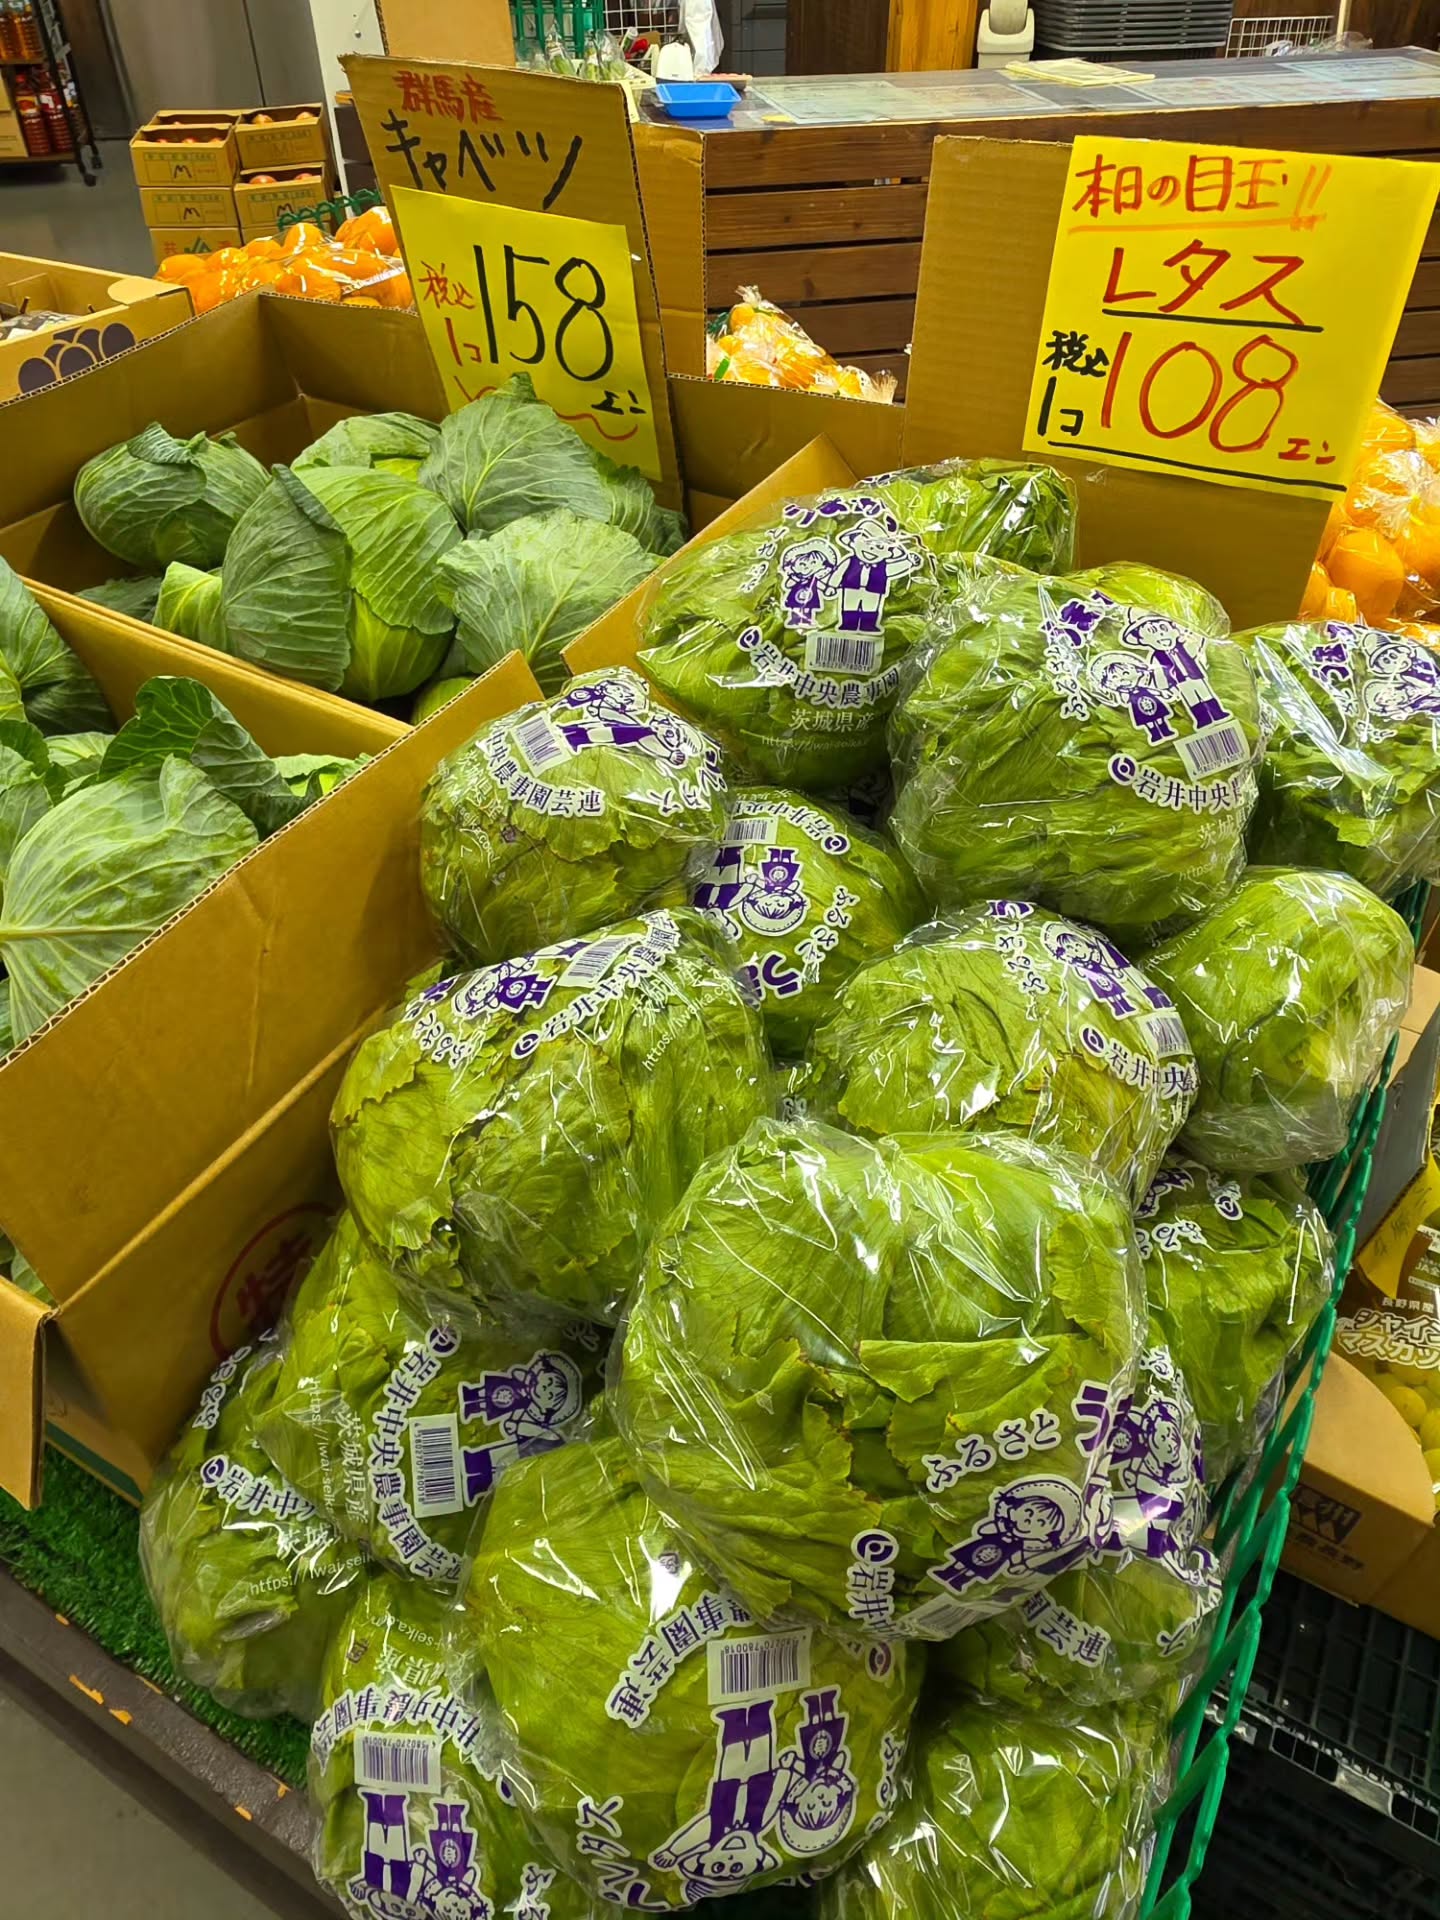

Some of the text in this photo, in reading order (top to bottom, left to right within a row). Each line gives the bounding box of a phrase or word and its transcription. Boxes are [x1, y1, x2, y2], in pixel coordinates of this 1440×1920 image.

[394, 68, 503, 124] 群馬産
[380, 107, 583, 210] キャベツ
[472, 243, 615, 382] 158
[1102, 238, 1304, 328] レタス
[1101, 331, 1300, 453] 108
[1136, 768, 1244, 812] 岩井中央
[926, 1413, 1058, 1488] ふるさと
